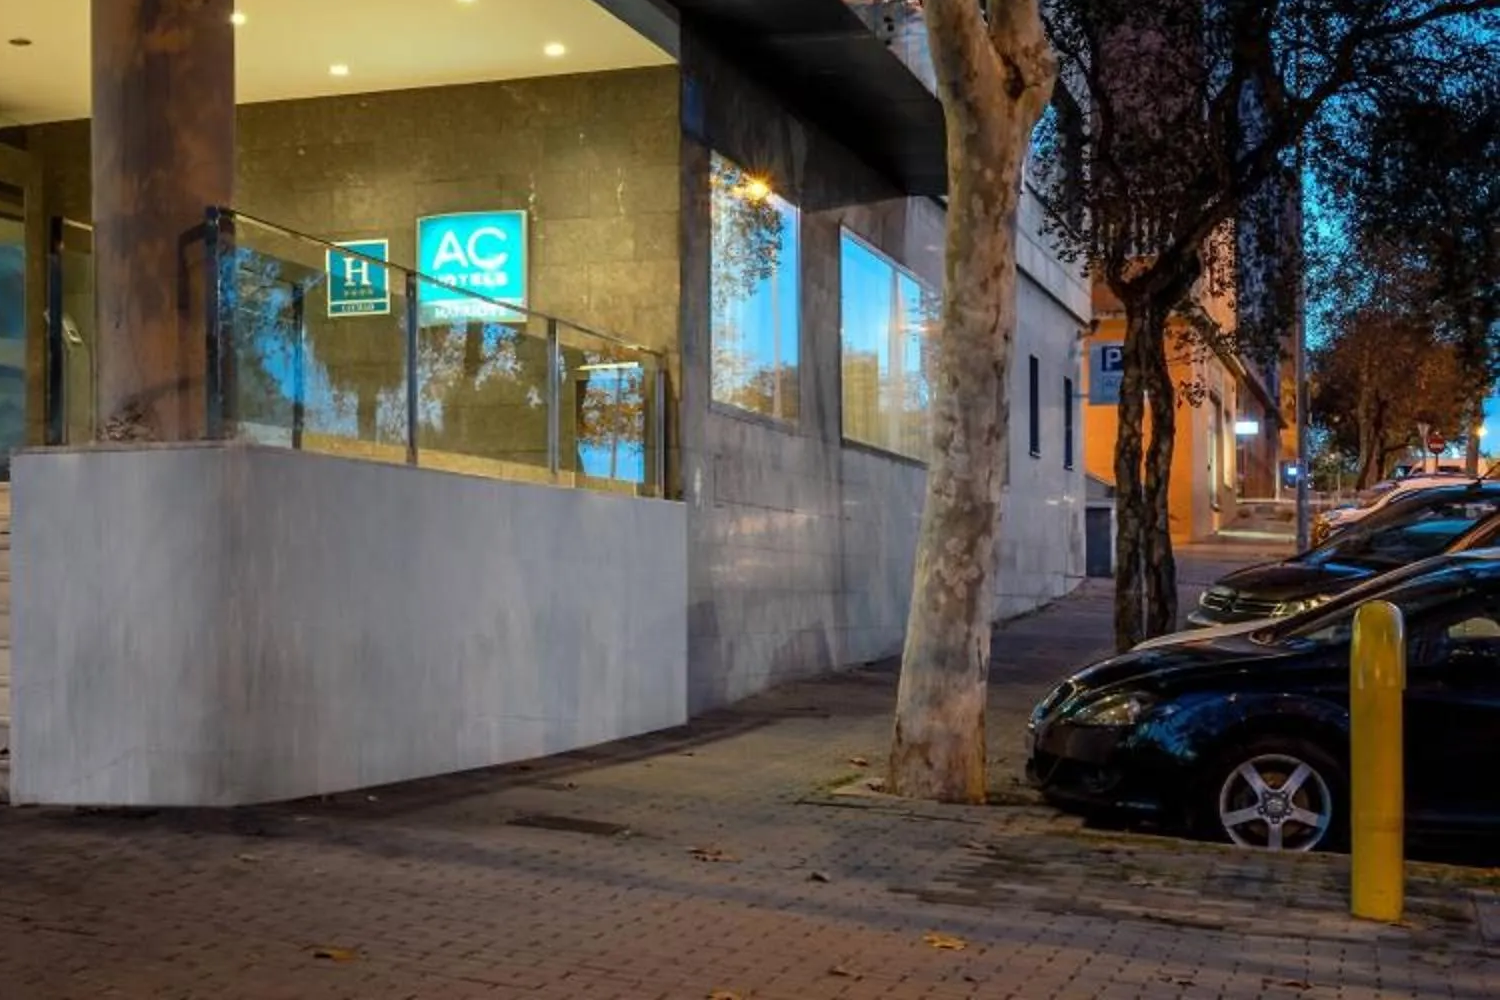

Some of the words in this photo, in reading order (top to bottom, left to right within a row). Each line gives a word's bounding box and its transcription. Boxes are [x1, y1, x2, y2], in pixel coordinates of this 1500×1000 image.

[432, 226, 509, 271] AC
[343, 256, 373, 287] H
[1105, 349, 1122, 369] P
